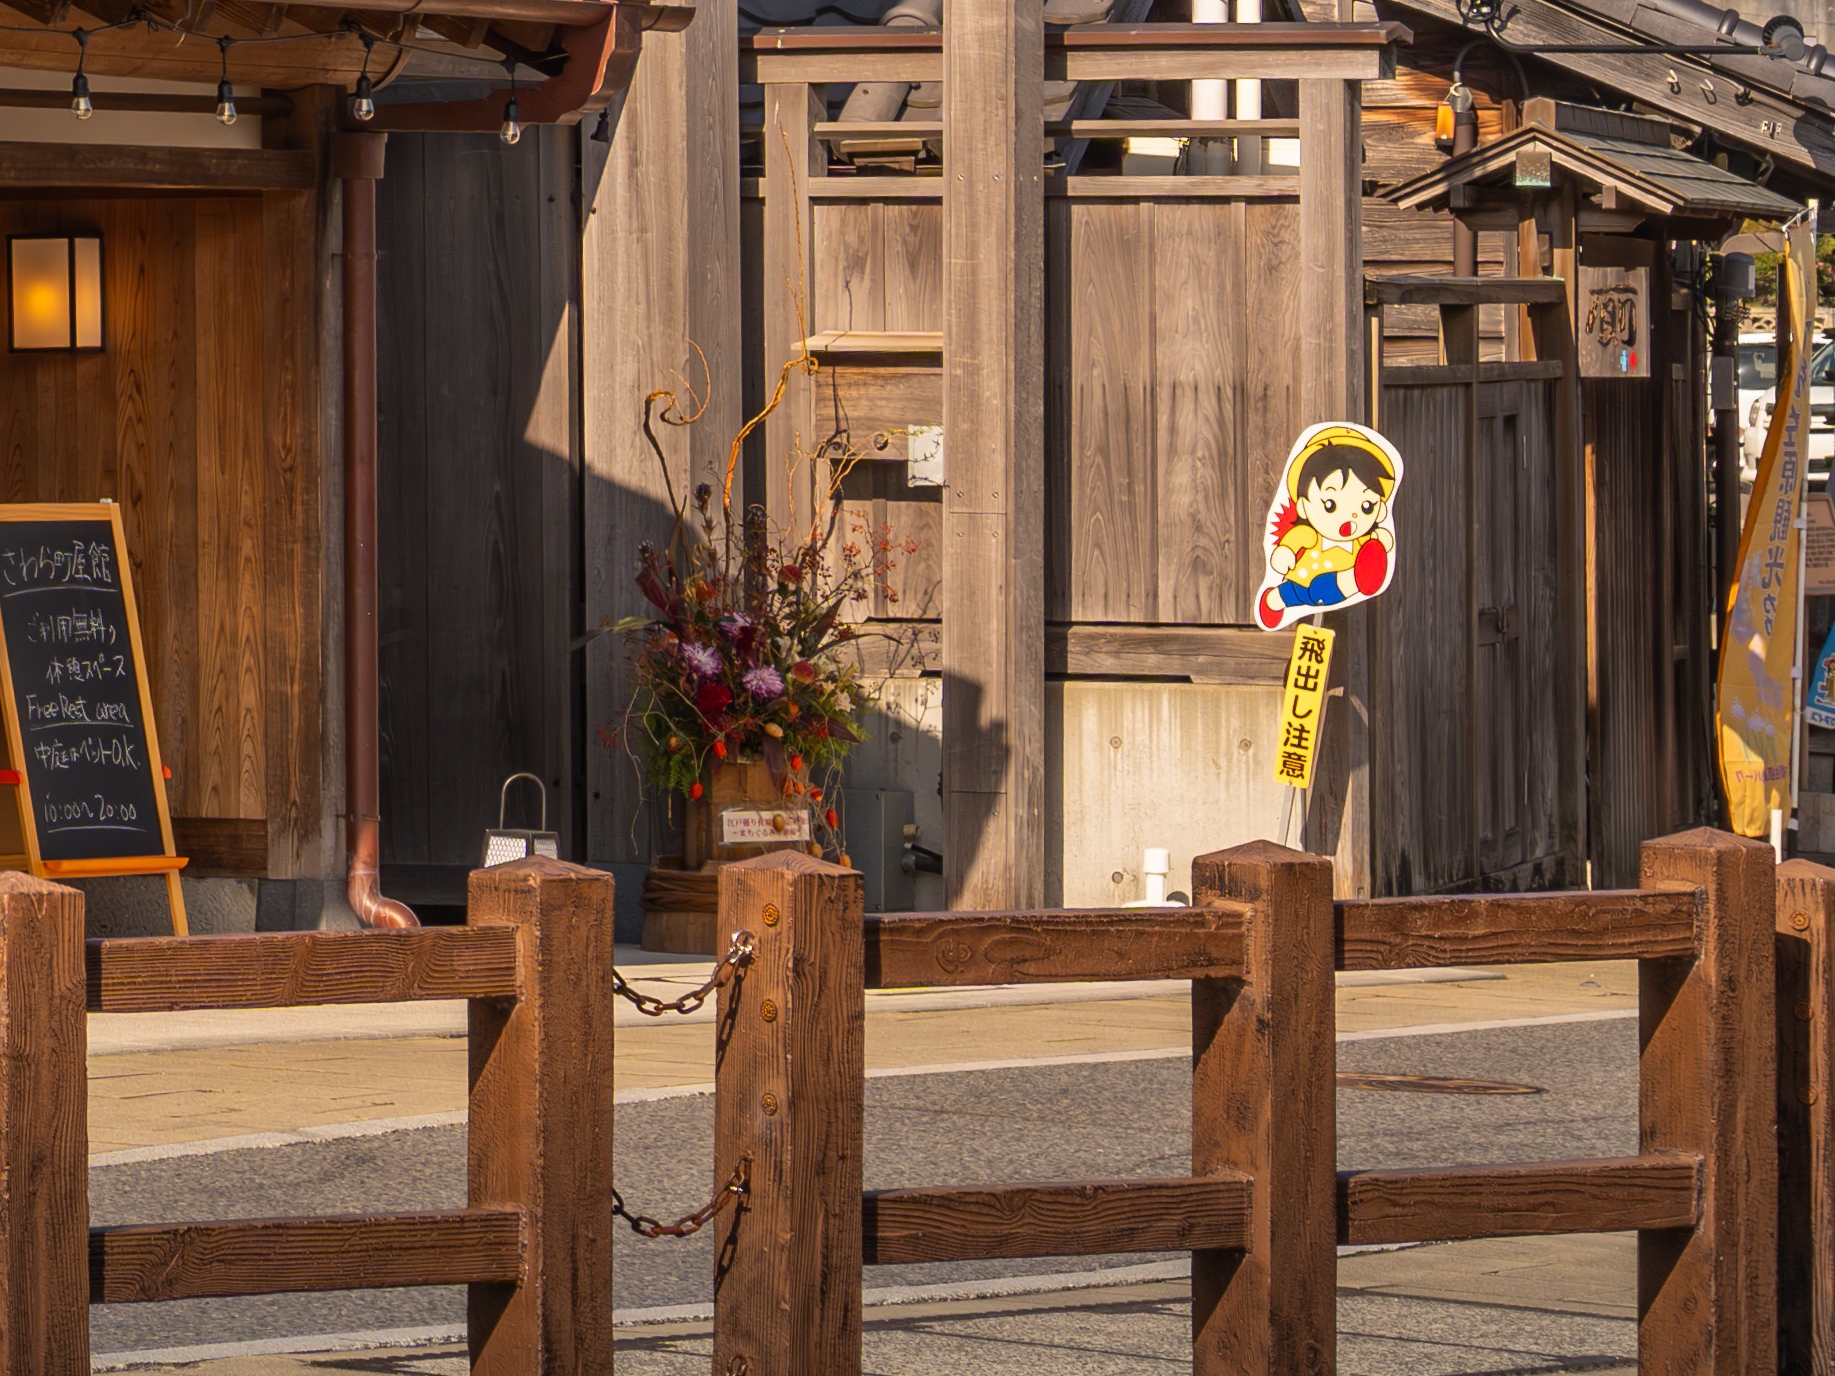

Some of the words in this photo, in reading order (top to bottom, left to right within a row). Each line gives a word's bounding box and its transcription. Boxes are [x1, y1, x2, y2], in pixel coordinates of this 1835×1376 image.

[1, 540, 112, 585] さわら町屋館
[46, 653, 126, 684] 休憩スペース
[1279, 634, 1326, 781] 飛出し注意
